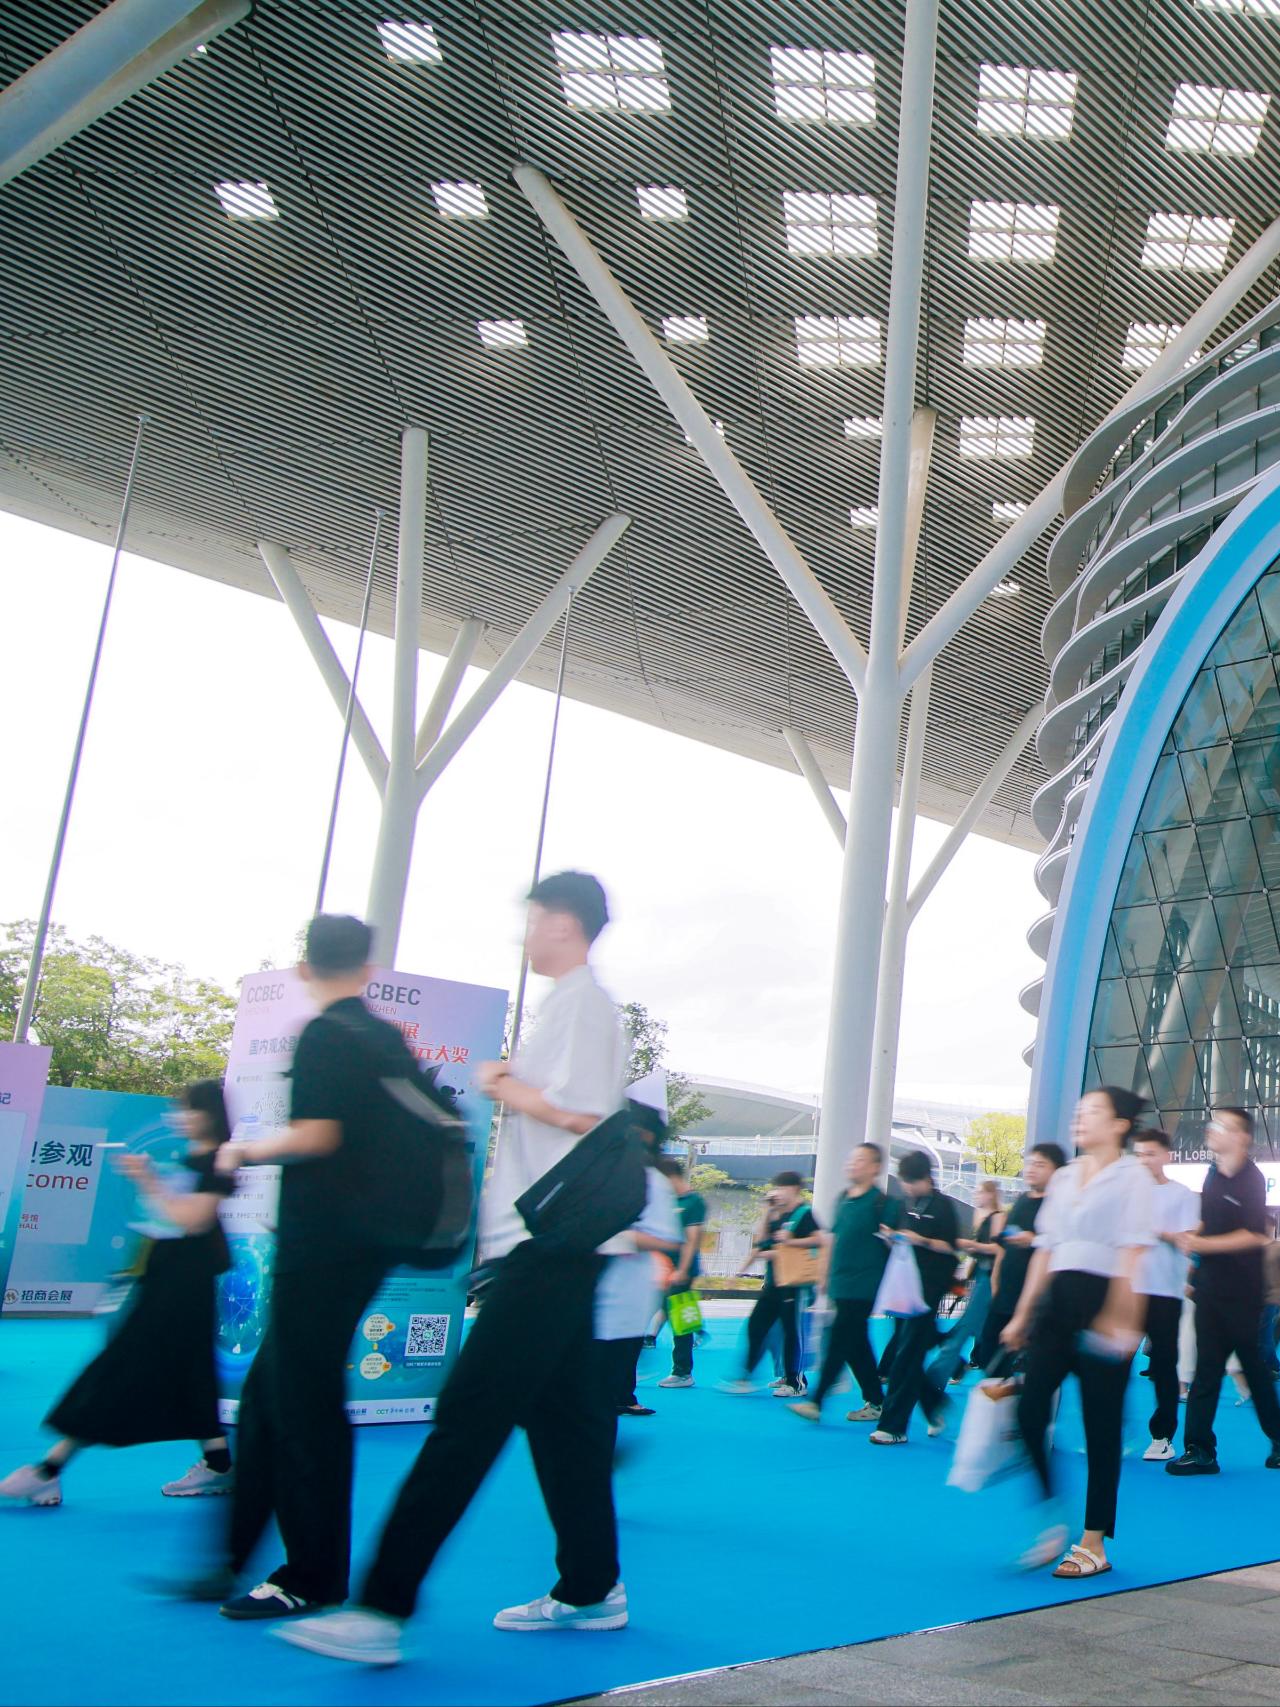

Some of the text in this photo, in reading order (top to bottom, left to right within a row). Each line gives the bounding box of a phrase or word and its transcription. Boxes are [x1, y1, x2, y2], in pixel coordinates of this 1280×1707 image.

[247, 983, 285, 1003] CCBEC
[362, 982, 421, 1006] CBEC
[31, 1140, 93, 1167] 参观
[21, 1290, 73, 1301] 招商会展
